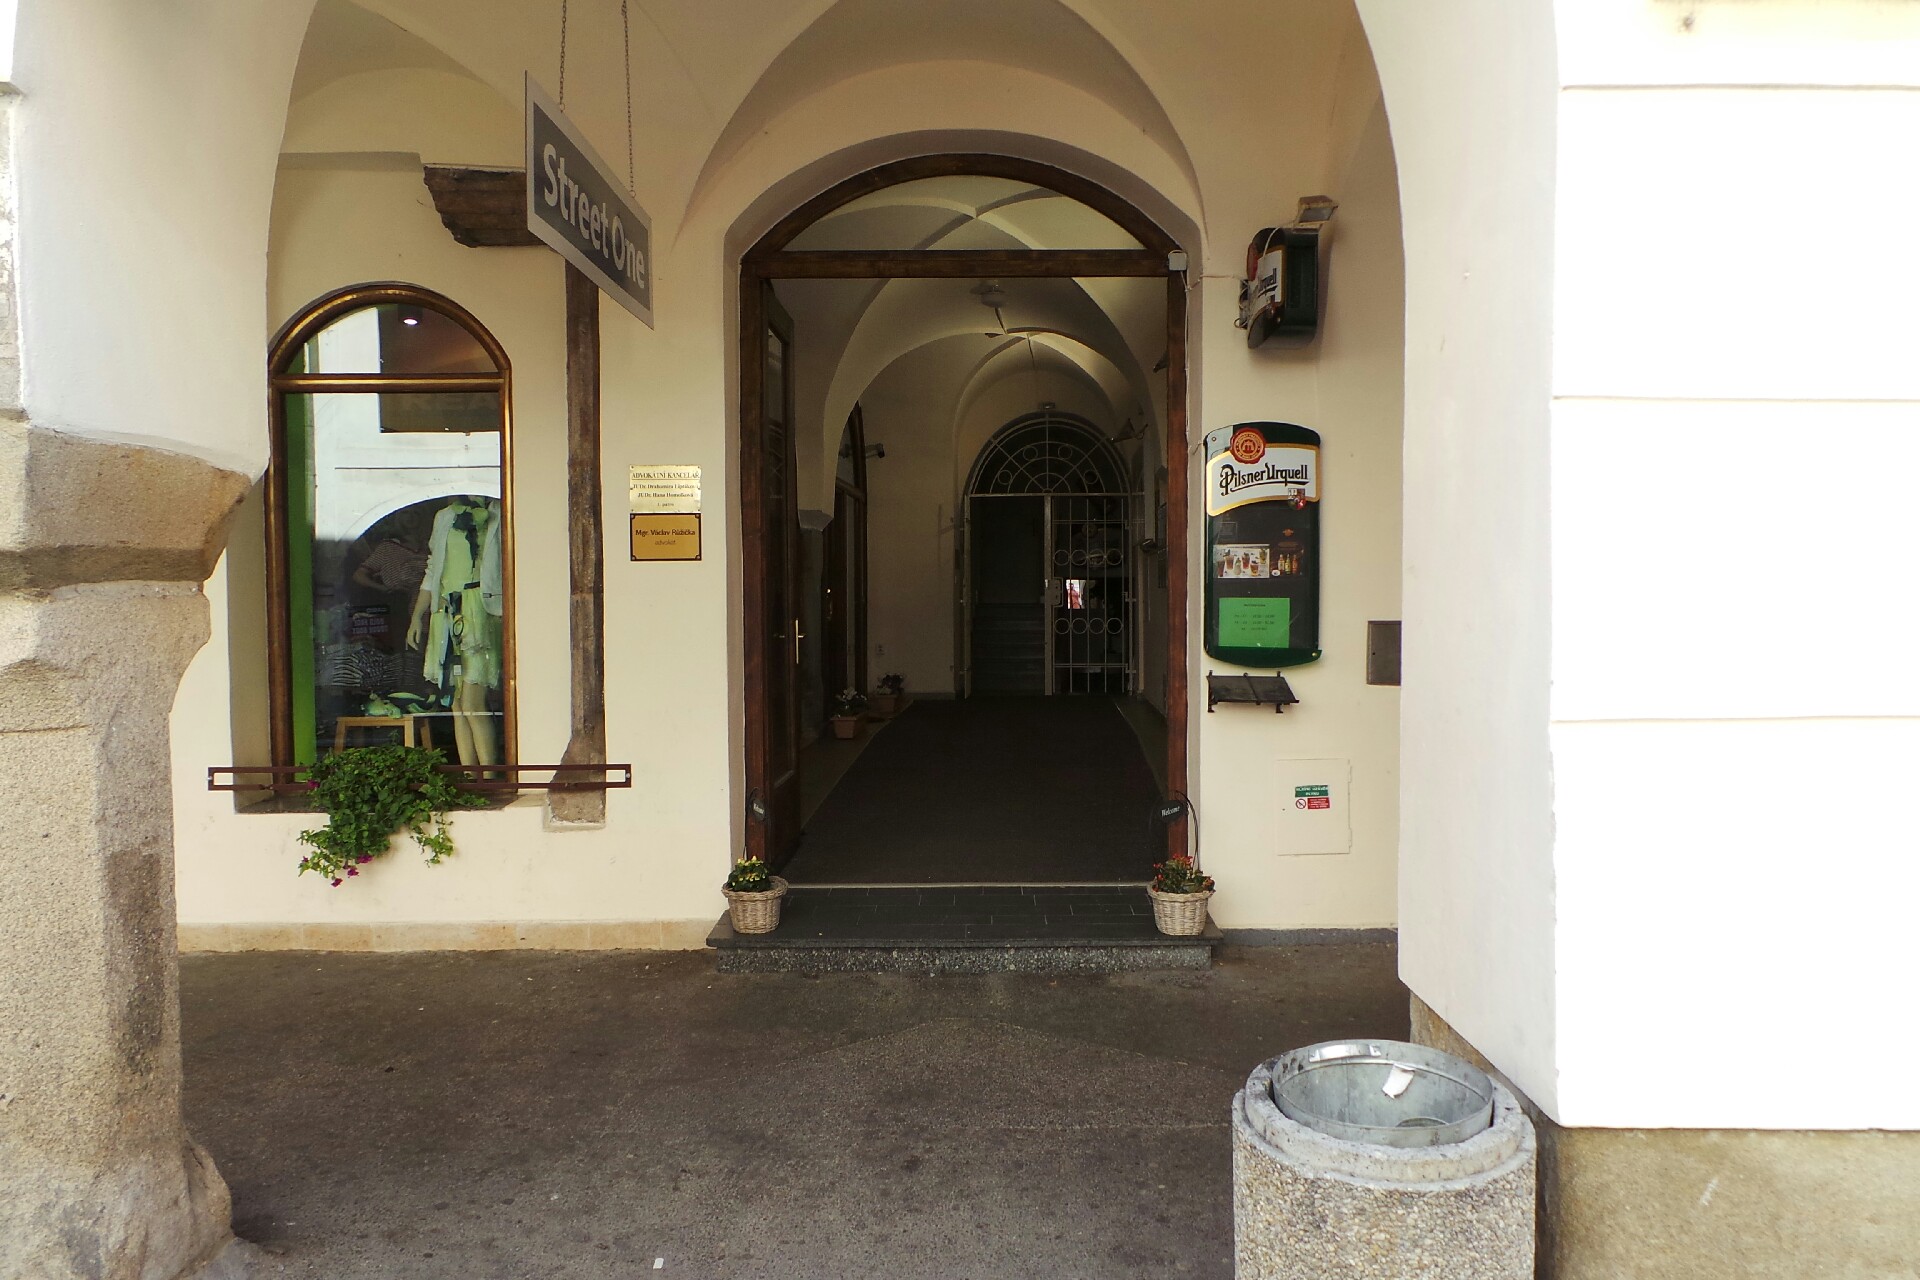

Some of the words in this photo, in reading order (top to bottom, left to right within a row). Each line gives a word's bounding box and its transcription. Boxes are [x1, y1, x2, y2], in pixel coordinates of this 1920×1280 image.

[543, 143, 609, 259] Street
[612, 215, 645, 289] One
[1219, 463, 1266, 496] Pilsner
[1265, 462, 1308, 487] Urquell
[650, 528, 670, 536] Václav
